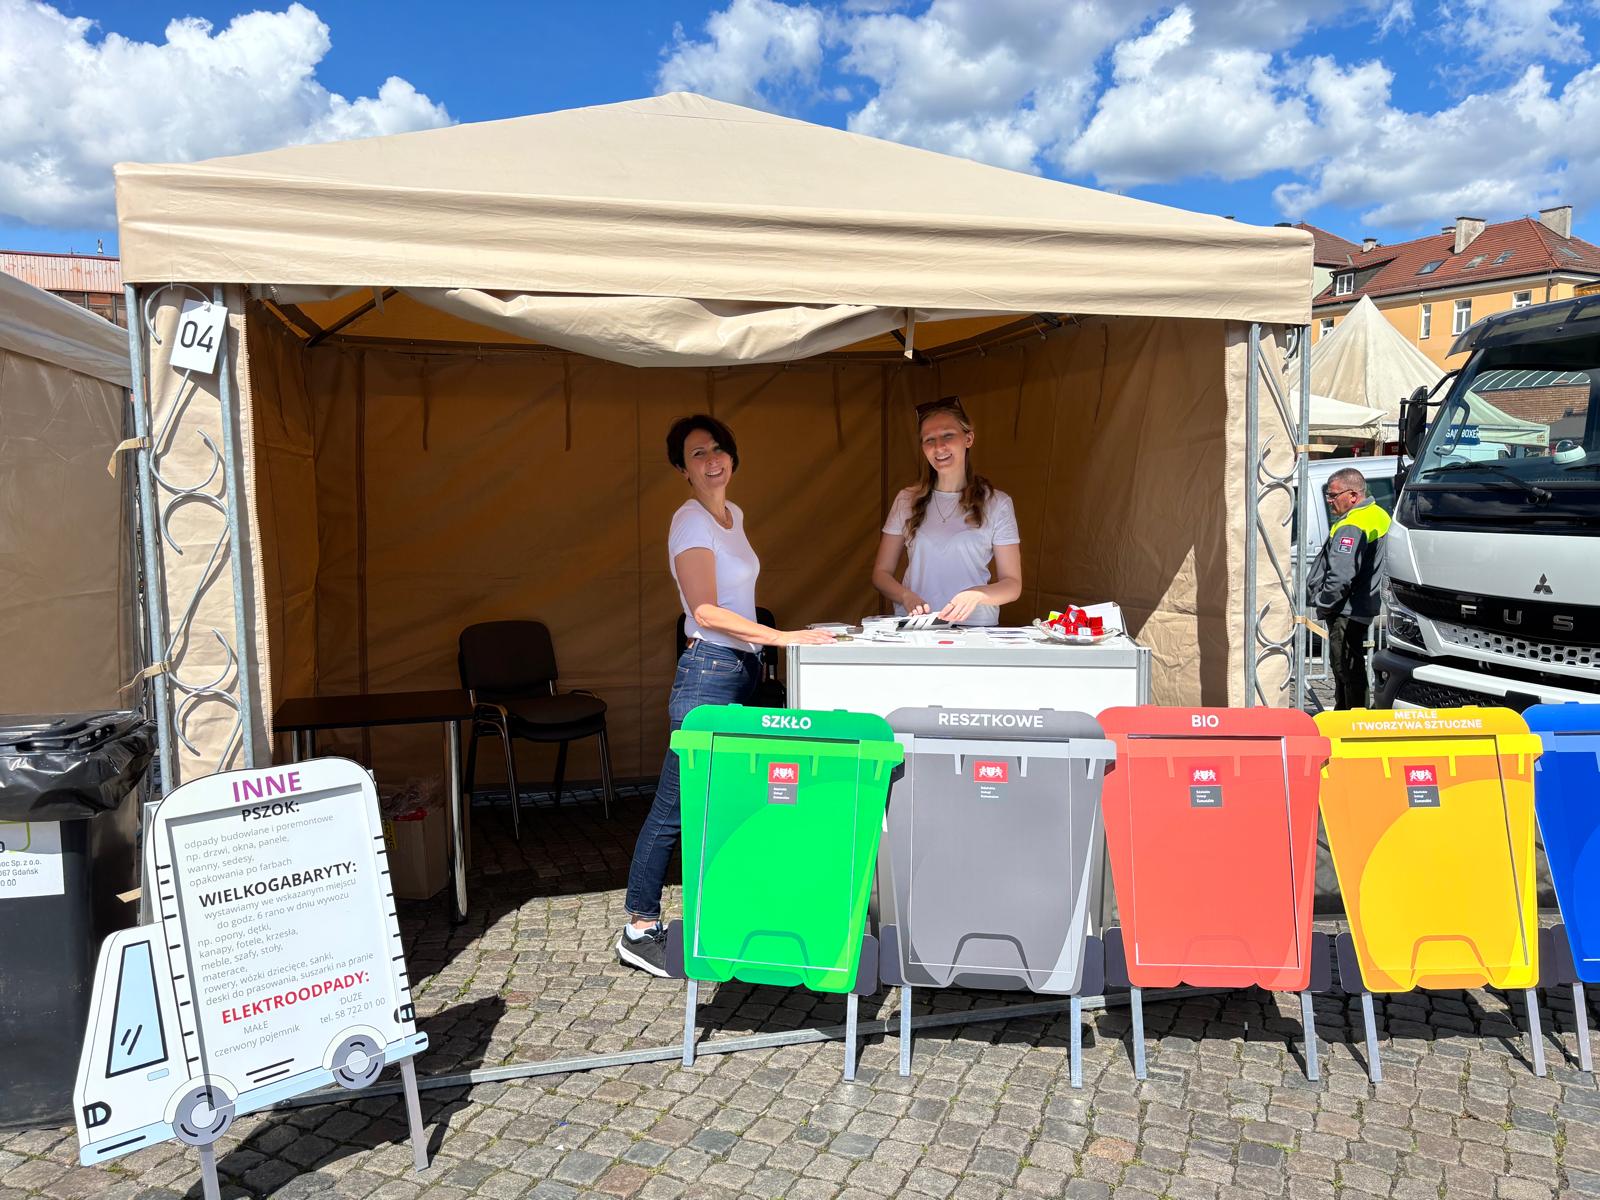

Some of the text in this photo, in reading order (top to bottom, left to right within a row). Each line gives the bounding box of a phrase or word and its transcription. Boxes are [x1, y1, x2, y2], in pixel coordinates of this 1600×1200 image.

[180, 320, 213, 353] 04
[761, 714, 812, 730] SZKŁO
[938, 713, 1044, 728] RESZTKOWE
[1191, 714, 1219, 728] BIO
[1357, 720, 1423, 730] TWORZYWA
[1424, 719, 1483, 729] SZTUCZNE
[1394, 711, 1437, 720] METALE
[232, 771, 302, 803] INNE
[241, 800, 300, 822] PSZOK:
[184, 836, 219, 850] odpady
[221, 827, 270, 842] budowlane
[276, 814, 334, 833] poremontowe
[186, 853, 201, 863] np.
[203, 846, 230, 858] drzwi,
[232, 842, 257, 853] okna,
[12, 867, 39, 876] Gdańsk
[187, 855, 255, 874] wanny, sedesy,
[189, 858, 292, 888] opakowania po farbach
[199, 861, 357, 907] WIELKOGABARYTY:
[204, 878, 357, 920] wystawiamy we wskazanym miejscu
[217, 892, 350, 930] do godz. 6 rano w dniu wywozu
[197, 939, 213, 948] np.
[215, 930, 246, 943] opony,
[199, 944, 235, 959] kanapy,
[201, 957, 233, 971] meble,
[234, 949, 259, 963] szafy,
[202, 965, 248, 983] materace,
[204, 980, 238, 995] rowery,
[239, 971, 265, 985] wózki
[309, 951, 334, 966] sanki,
[206, 952, 374, 1006] deski do prasowania, suszarki na pranie
[222, 970, 370, 1024] ELEKTROODPADY:
[340, 991, 364, 1006] DUŻE
[319, 996, 386, 1024] tel. 58 722 01 00
[243, 1020, 269, 1035] MAŁE
[214, 1023, 302, 1058] czerwony pojemnik
